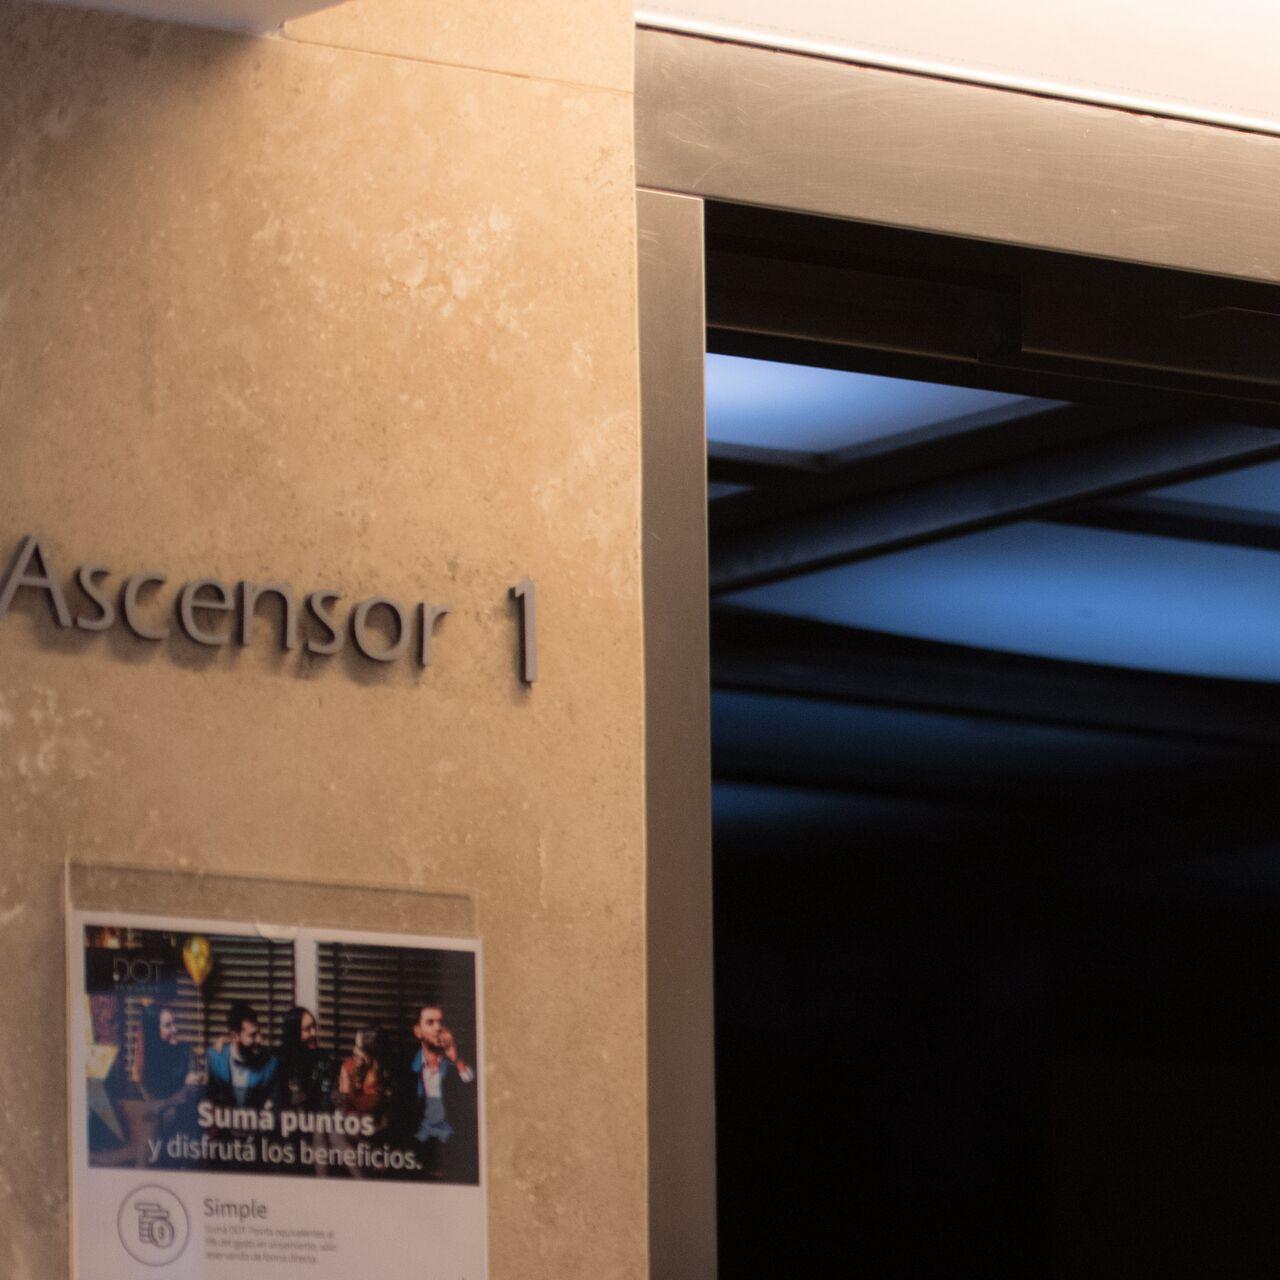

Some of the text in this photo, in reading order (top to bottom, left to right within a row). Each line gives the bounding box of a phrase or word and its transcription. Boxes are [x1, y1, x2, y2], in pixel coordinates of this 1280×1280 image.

[1, 534, 538, 685] Ascensor 1
[197, 1100, 375, 1138] Sumá puntos
[148, 1132, 424, 1170] y disfrutá los beneficios.
[203, 1198, 268, 1222] Simple
